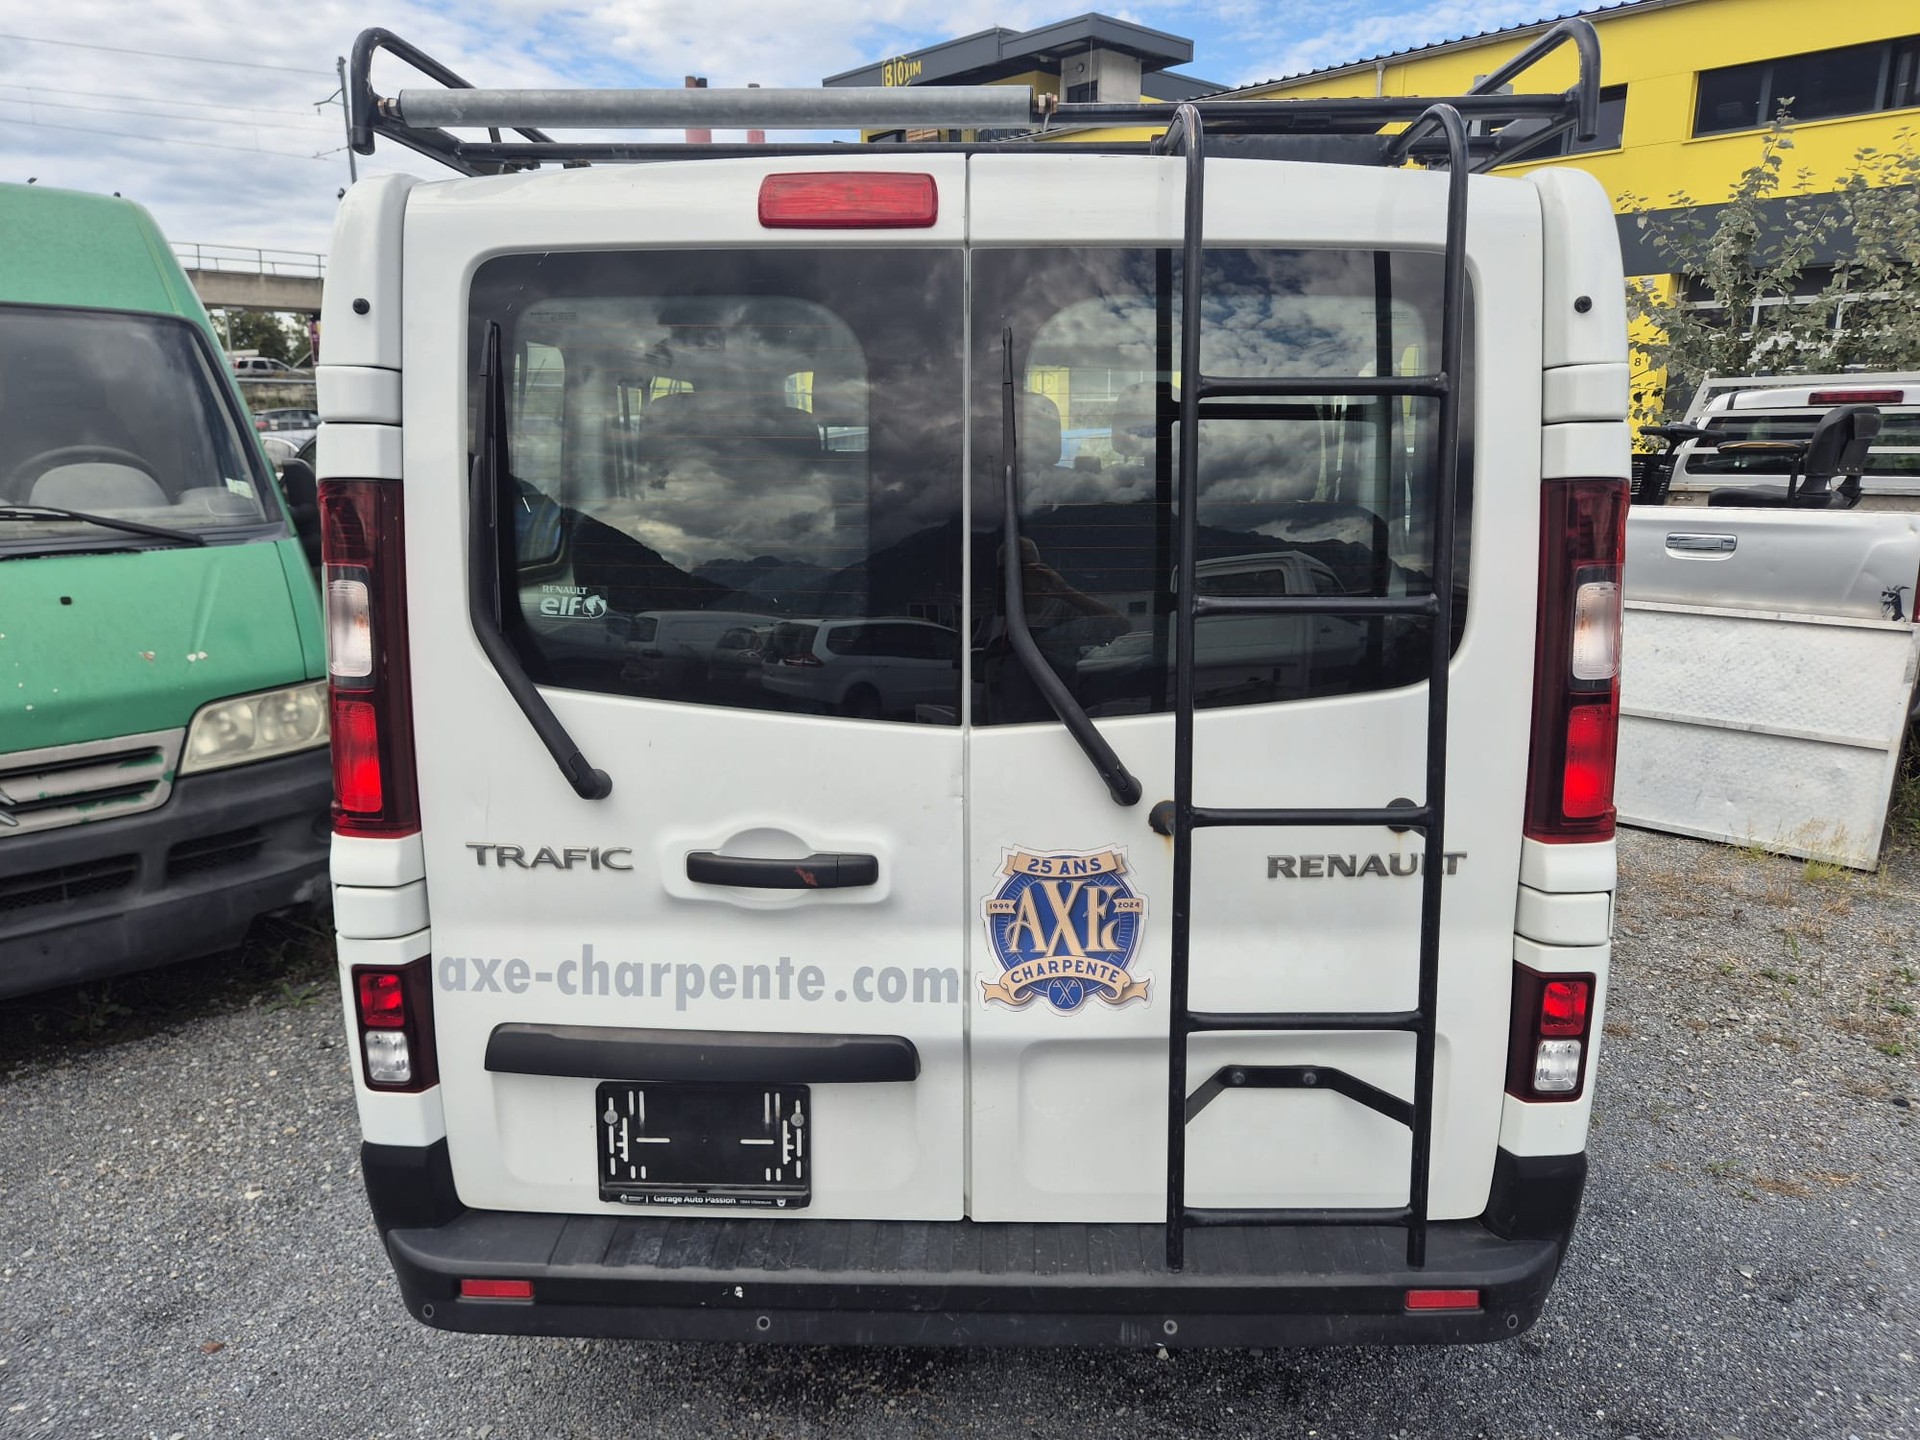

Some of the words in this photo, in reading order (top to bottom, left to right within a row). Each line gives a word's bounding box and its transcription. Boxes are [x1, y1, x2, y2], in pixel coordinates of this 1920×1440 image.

[1634, 357, 1642, 367] 8
[542, 585, 587, 595] RENAULT
[541, 597, 582, 615] elf
[465, 841, 634, 870] TRAFIC
[1267, 851, 1468, 879] RENAUT
[1027, 858, 1053, 875] 25
[1058, 857, 1102, 876] ANS
[1117, 901, 1140, 909] 2024
[1005, 878, 1126, 958] AXE
[437, 943, 961, 1012] axe-charpente.com
[1010, 959, 1121, 985] CHARPENTE
[653, 1194, 683, 1204] Garage
[684, 1196, 704, 1204] Auto
[705, 1197, 737, 1205] Passion
